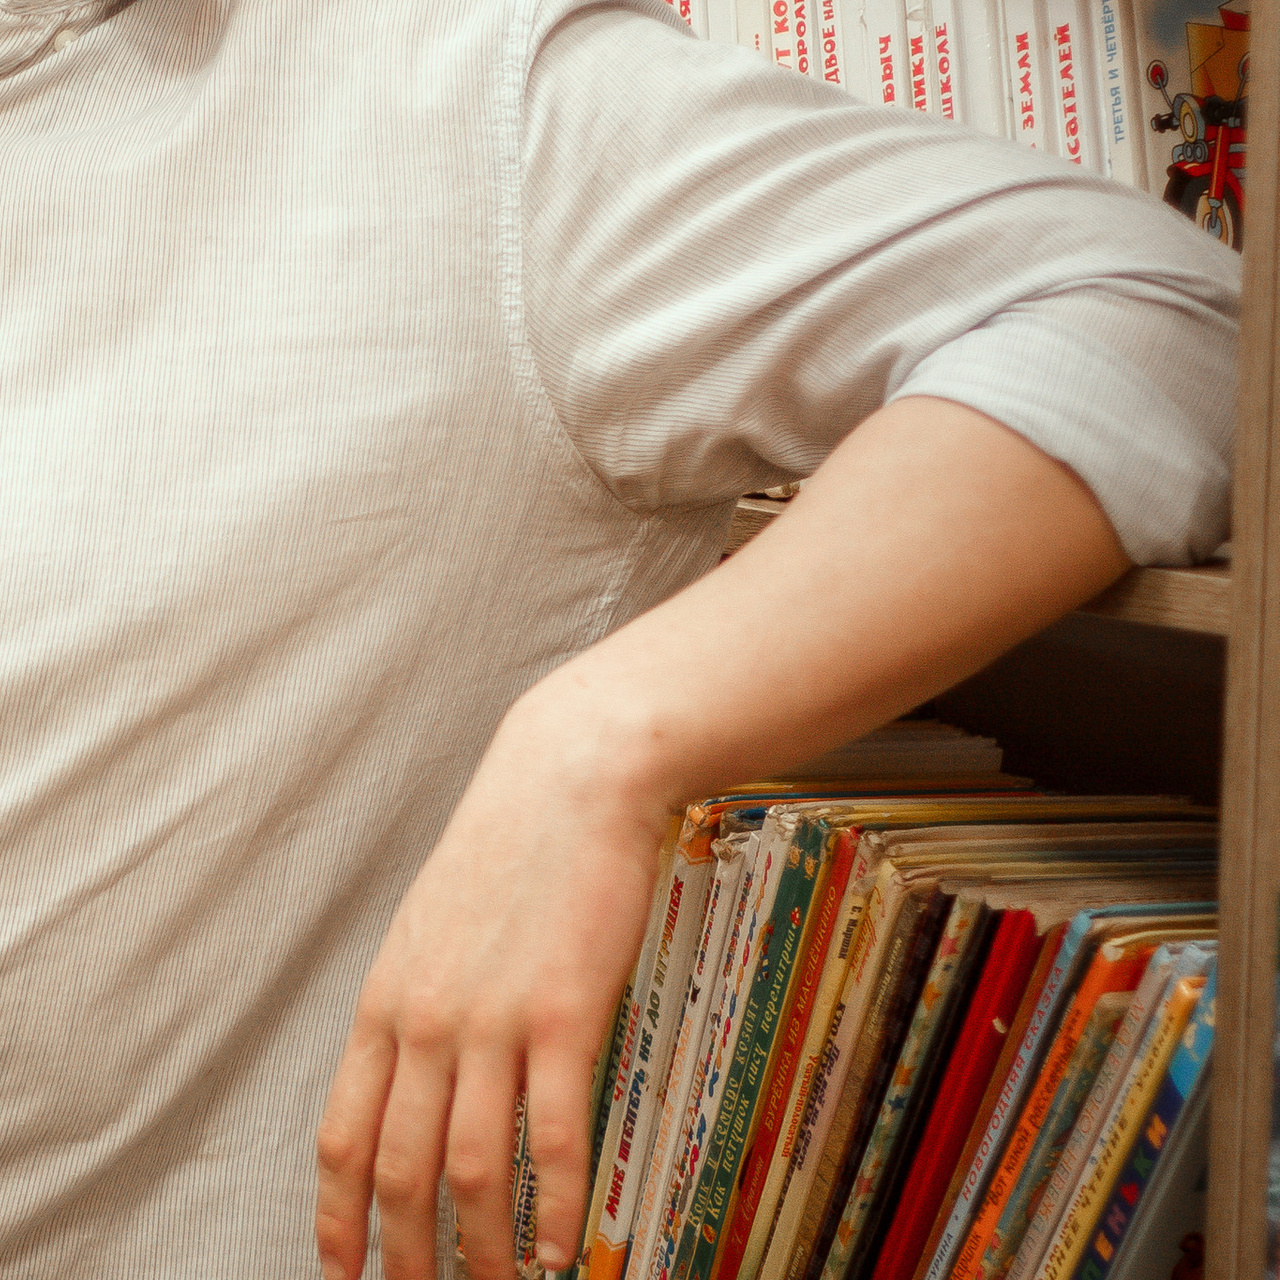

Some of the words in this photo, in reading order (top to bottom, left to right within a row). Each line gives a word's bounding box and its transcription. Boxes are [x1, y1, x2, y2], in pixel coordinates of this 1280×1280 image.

[822, 23, 841, 85] ДВОЕ
[935, 21, 955, 120] ШКОЛЕ
[1015, 31, 1036, 131] ЗЕМЛИ
[1109, 67, 1119, 80] И
[1106, 85, 1125, 146] ТРЕТЬЯ
[651, 873, 687, 988] ИГРУШЕК
[792, 884, 838, 1015] МАСЛЁНКИНО
[642, 988, 664, 1029] ДО
[785, 1017, 802, 1044] ИЗ
[762, 1049, 794, 1131] БУРЁНКА
[962, 1054, 1026, 1200] НОВОГОДНЯЯ
[1023, 964, 1063, 1049] СКАЗКА
[602, 1164, 627, 1220] МНЕ
[705, 1178, 729, 1220] Как
[719, 1092, 754, 1174] петушок
